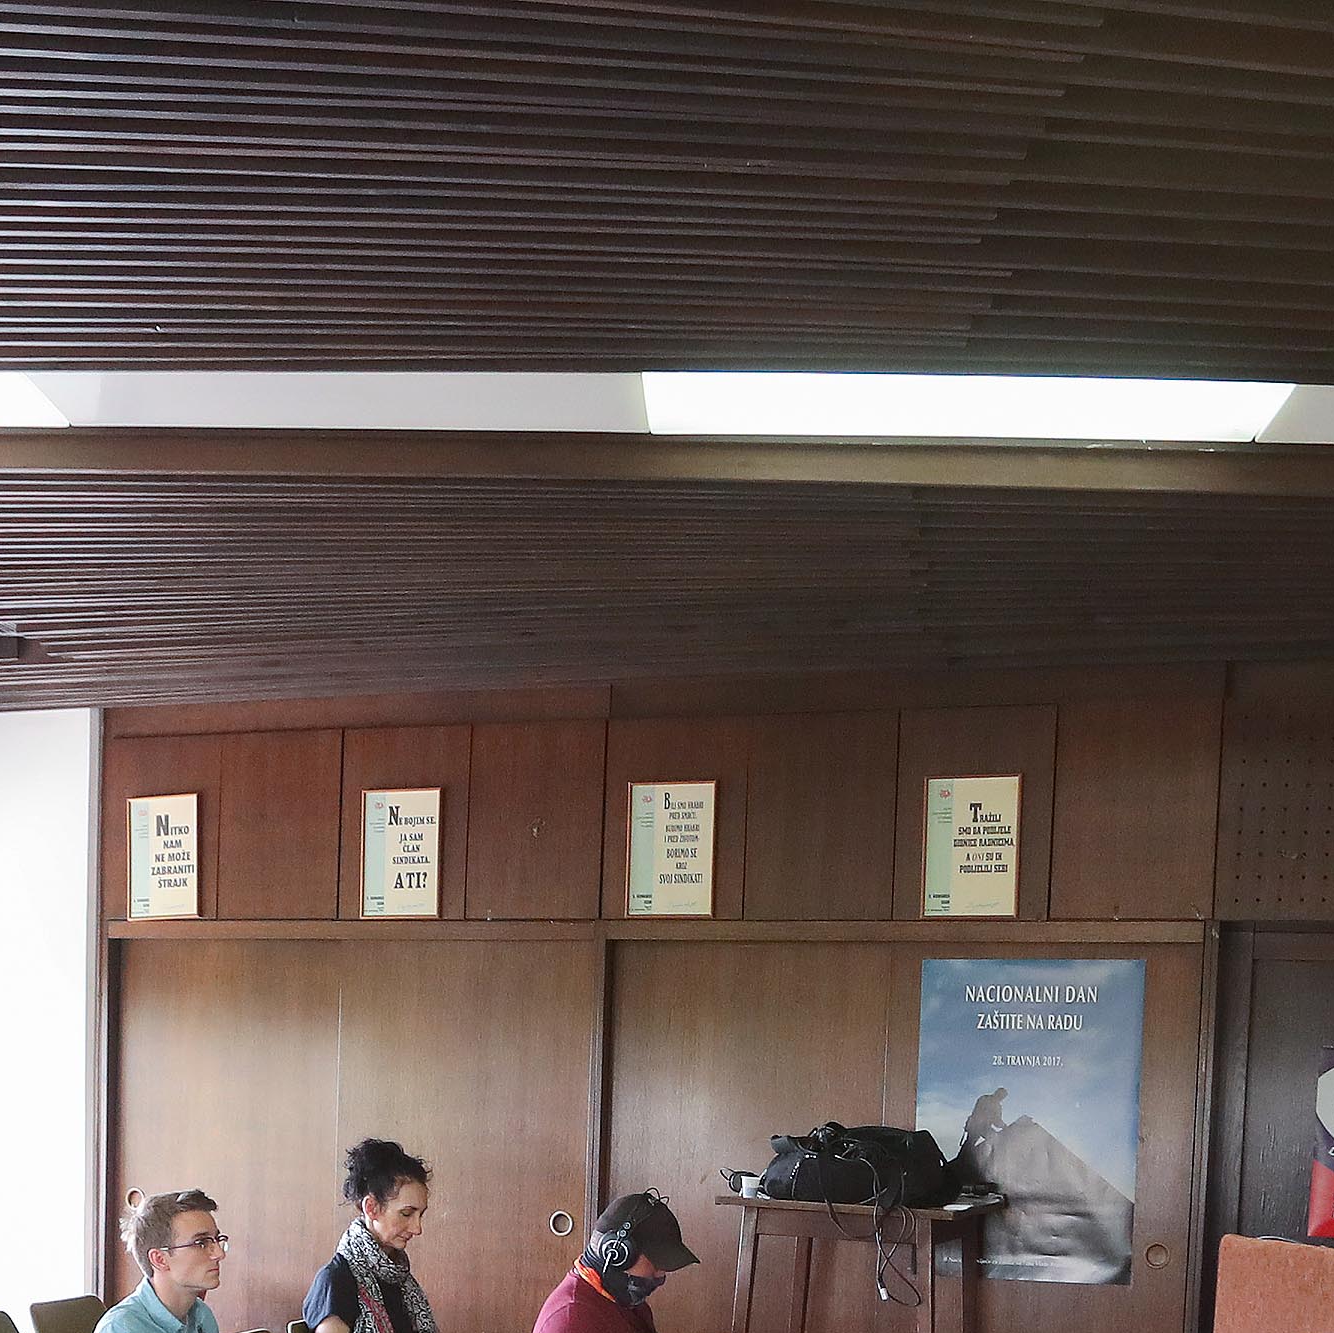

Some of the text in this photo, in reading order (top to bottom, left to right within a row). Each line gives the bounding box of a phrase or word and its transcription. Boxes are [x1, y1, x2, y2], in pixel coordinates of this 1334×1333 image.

[156, 814, 189, 836] NITKO
[399, 832, 423, 843] JA SAM
[163, 839, 182, 849] NAM
[155, 850, 191, 863] NE MOŽE
[690, 847, 698, 858] SE
[151, 864, 195, 876] ZABRANITI
[965, 984, 1099, 1003] NACIONALNI DAN
[977, 1010, 1083, 1030] ZAŠTITE NA RADU
[992, 1055, 1005, 1066] 28.
[1006, 1055, 1041, 1067] TRAVNJA
